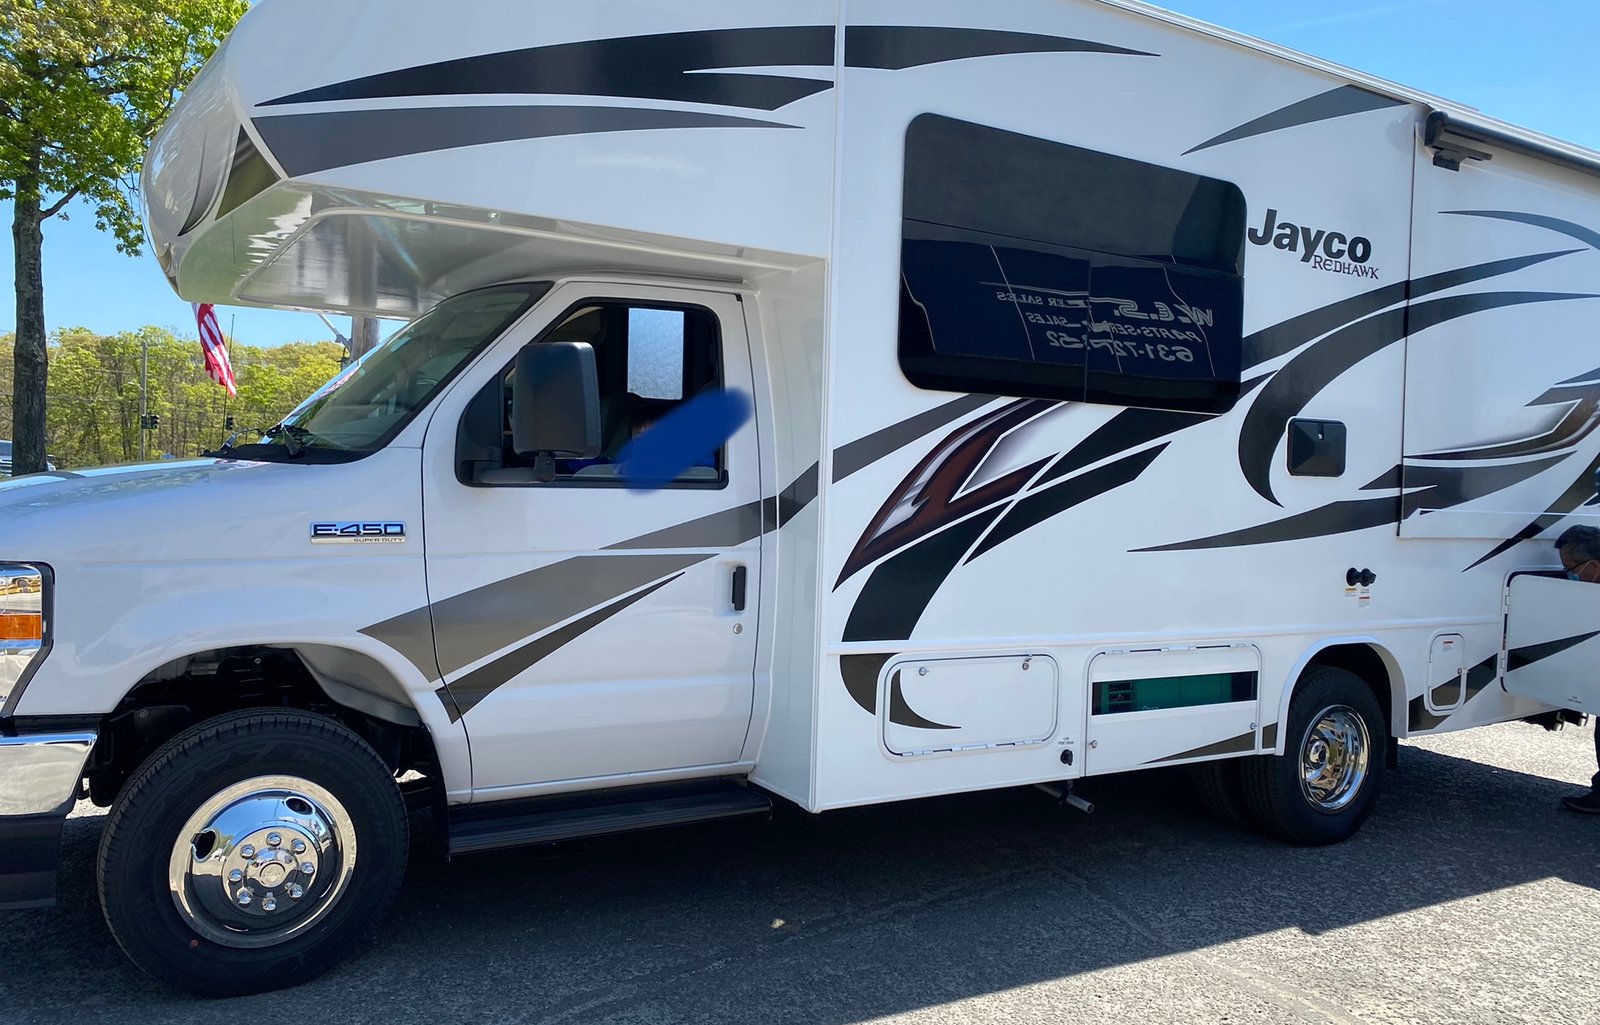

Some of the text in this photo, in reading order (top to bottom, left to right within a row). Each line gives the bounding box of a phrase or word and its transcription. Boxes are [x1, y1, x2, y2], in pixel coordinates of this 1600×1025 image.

[1248, 208, 1371, 263] Jayco
[1312, 254, 1379, 280] REDHAWK
[313, 523, 405, 537] E-450
